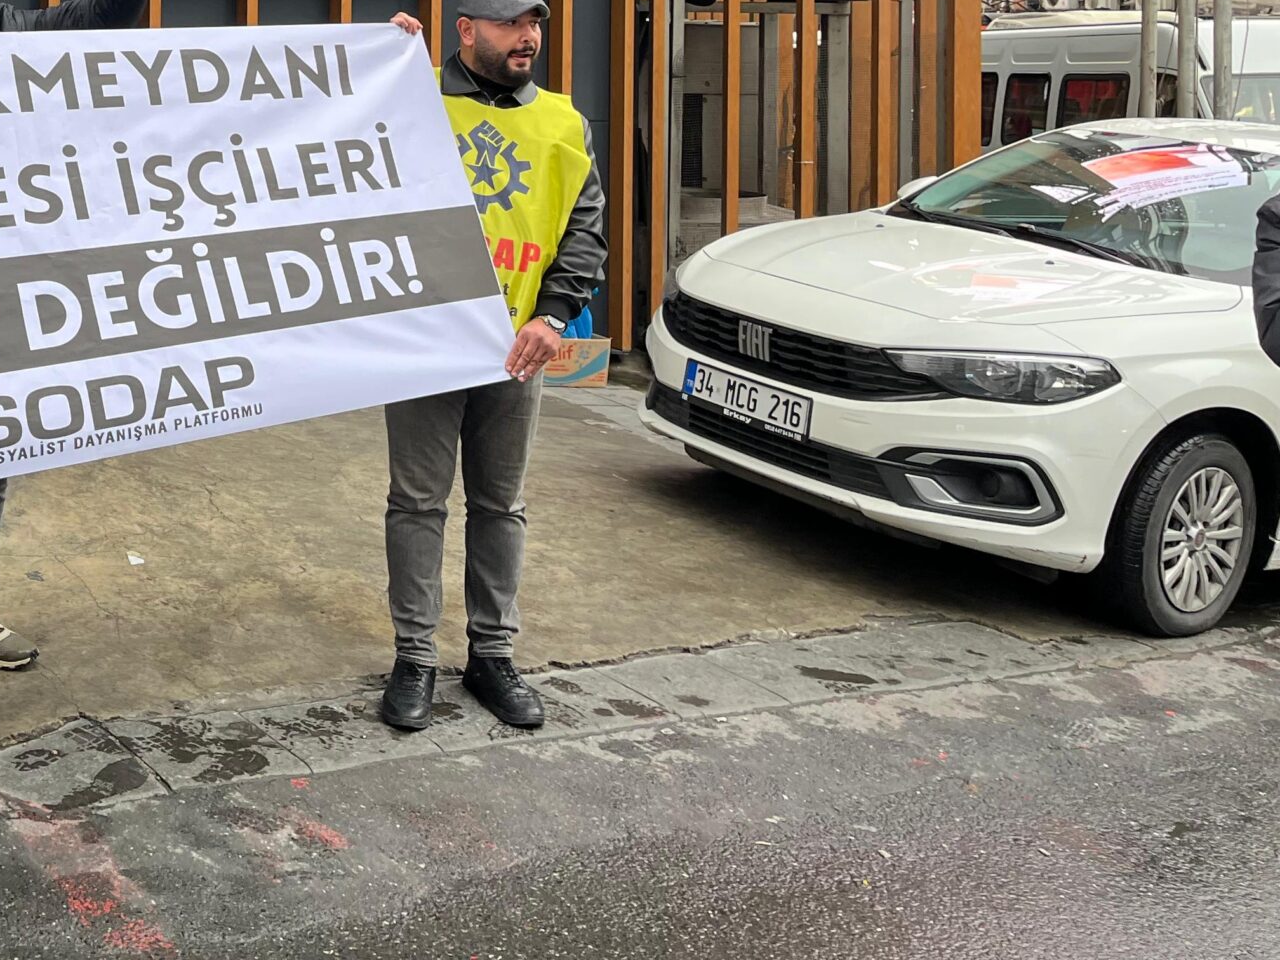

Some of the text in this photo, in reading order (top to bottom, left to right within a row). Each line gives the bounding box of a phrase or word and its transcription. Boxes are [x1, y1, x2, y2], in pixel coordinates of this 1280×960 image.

[116, 121, 403, 232] İŞÇİLERİ
[16, 227, 425, 352] DEĞİLDİR!
[738, 319, 773, 362] FIAT
[74, 422, 168, 451] DAYANIŞMA
[174, 402, 264, 432] PLATFORMU
[694, 368, 802, 428] 34 MCG 216
